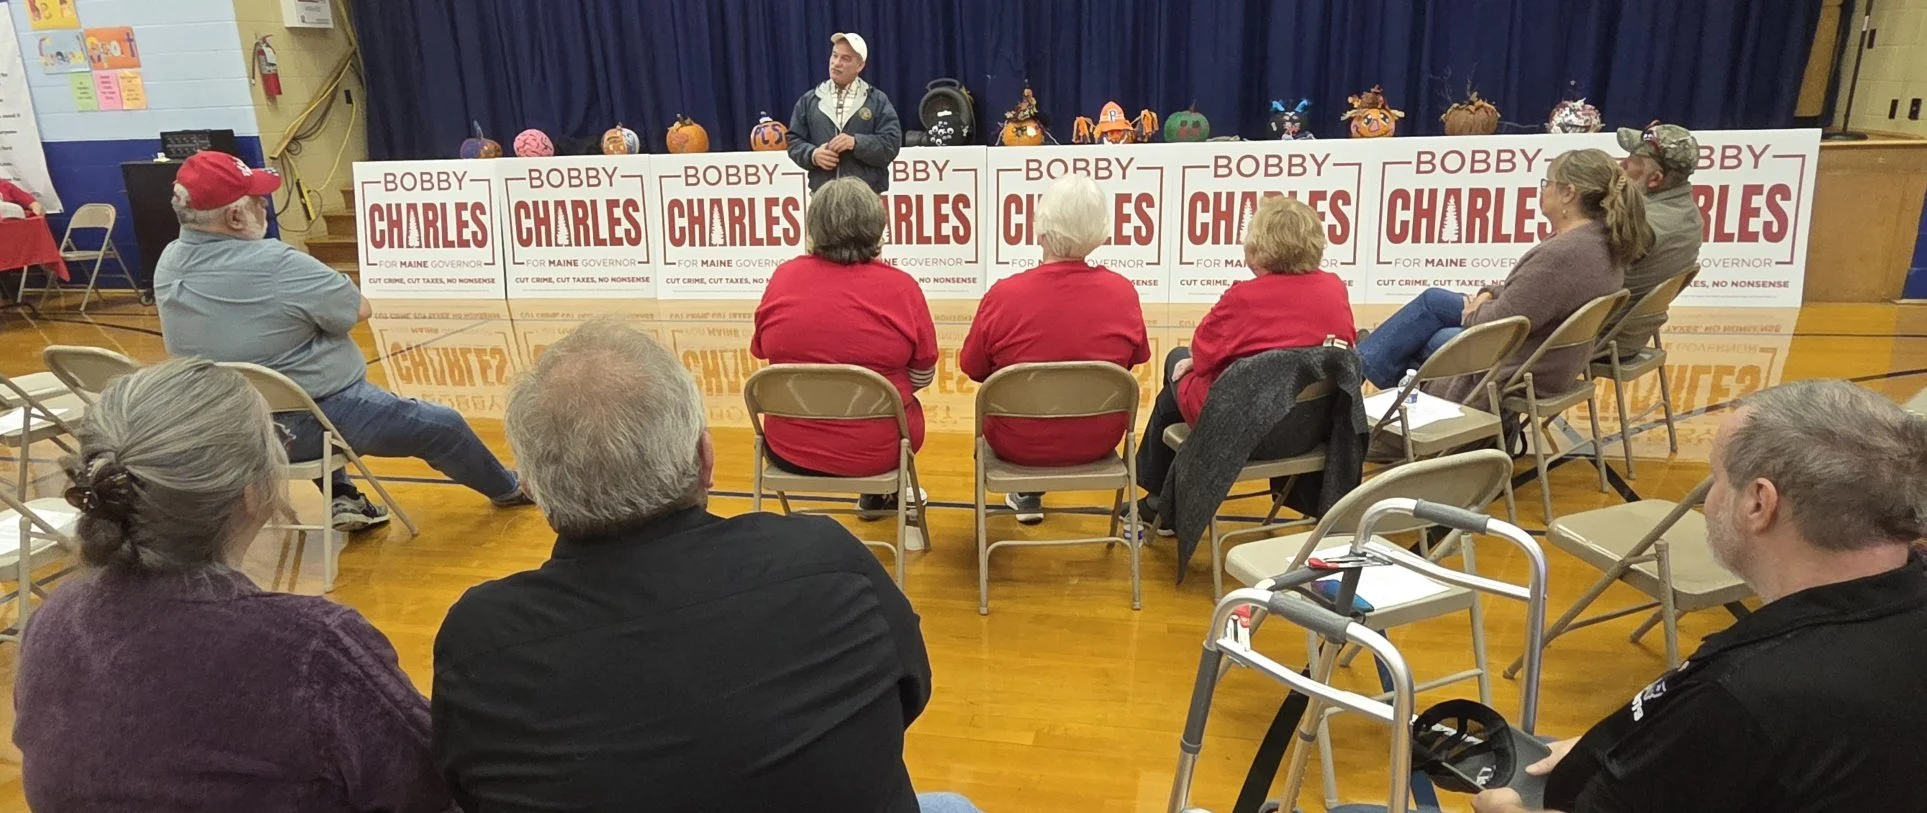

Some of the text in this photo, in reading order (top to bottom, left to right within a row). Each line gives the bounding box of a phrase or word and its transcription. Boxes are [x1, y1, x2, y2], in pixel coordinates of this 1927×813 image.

[1416, 148, 1543, 174] BOBBY
[1696, 144, 1772, 170] BBY
[892, 159, 950, 182] BBY
[1025, 157, 1134, 181] BOBBY
[1213, 153, 1331, 178] BOBBY
[383, 170, 468, 192] BOBBY
[528, 166, 618, 189] BOBBY
[684, 163, 779, 187] BOBBY
[881, 193, 972, 246] RLES
[1003, 192, 1155, 246] CHES
[1187, 189, 1352, 246] CHAES
[1692, 183, 1792, 244] RLES
[368, 201, 488, 249] CHARLES
[514, 197, 642, 248] CHARLES
[667, 196, 801, 248] CHARLES
[378, 259, 483, 269] FOR MAINE GOVERNOR
[525, 258, 637, 267] FOR MAINE GOVERNOR
[677, 258, 785, 268] FOR MAINE GOVERN
[901, 257, 963, 267] GOVERNOR
[1011, 258, 1034, 268] FOR
[1087, 258, 1144, 269] OVERNOR
[1196, 258, 1249, 268] FOR MAI
[1394, 257, 1518, 268] FOR MAINE GOVER
[1701, 257, 1772, 268] OVERNOR
[383, 277, 406, 285] CRIME,
[422, 277, 445, 285] TAXES,
[665, 277, 680, 285] CUT
[682, 277, 707, 285] CRIME,
[708, 277, 723, 285] CUT
[725, 277, 751, 285] TAXES,
[1131, 279, 1159, 287] SENSE
[1179, 279, 1198, 287] CUT
[1200, 279, 1230, 288] CRIME,
[1376, 279, 1396, 287] CUT
[1398, 279, 1430, 288] CRIME,
[1433, 279, 1455, 287] CUT
[1688, 280, 1790, 289] XES, NO NONSENSE
